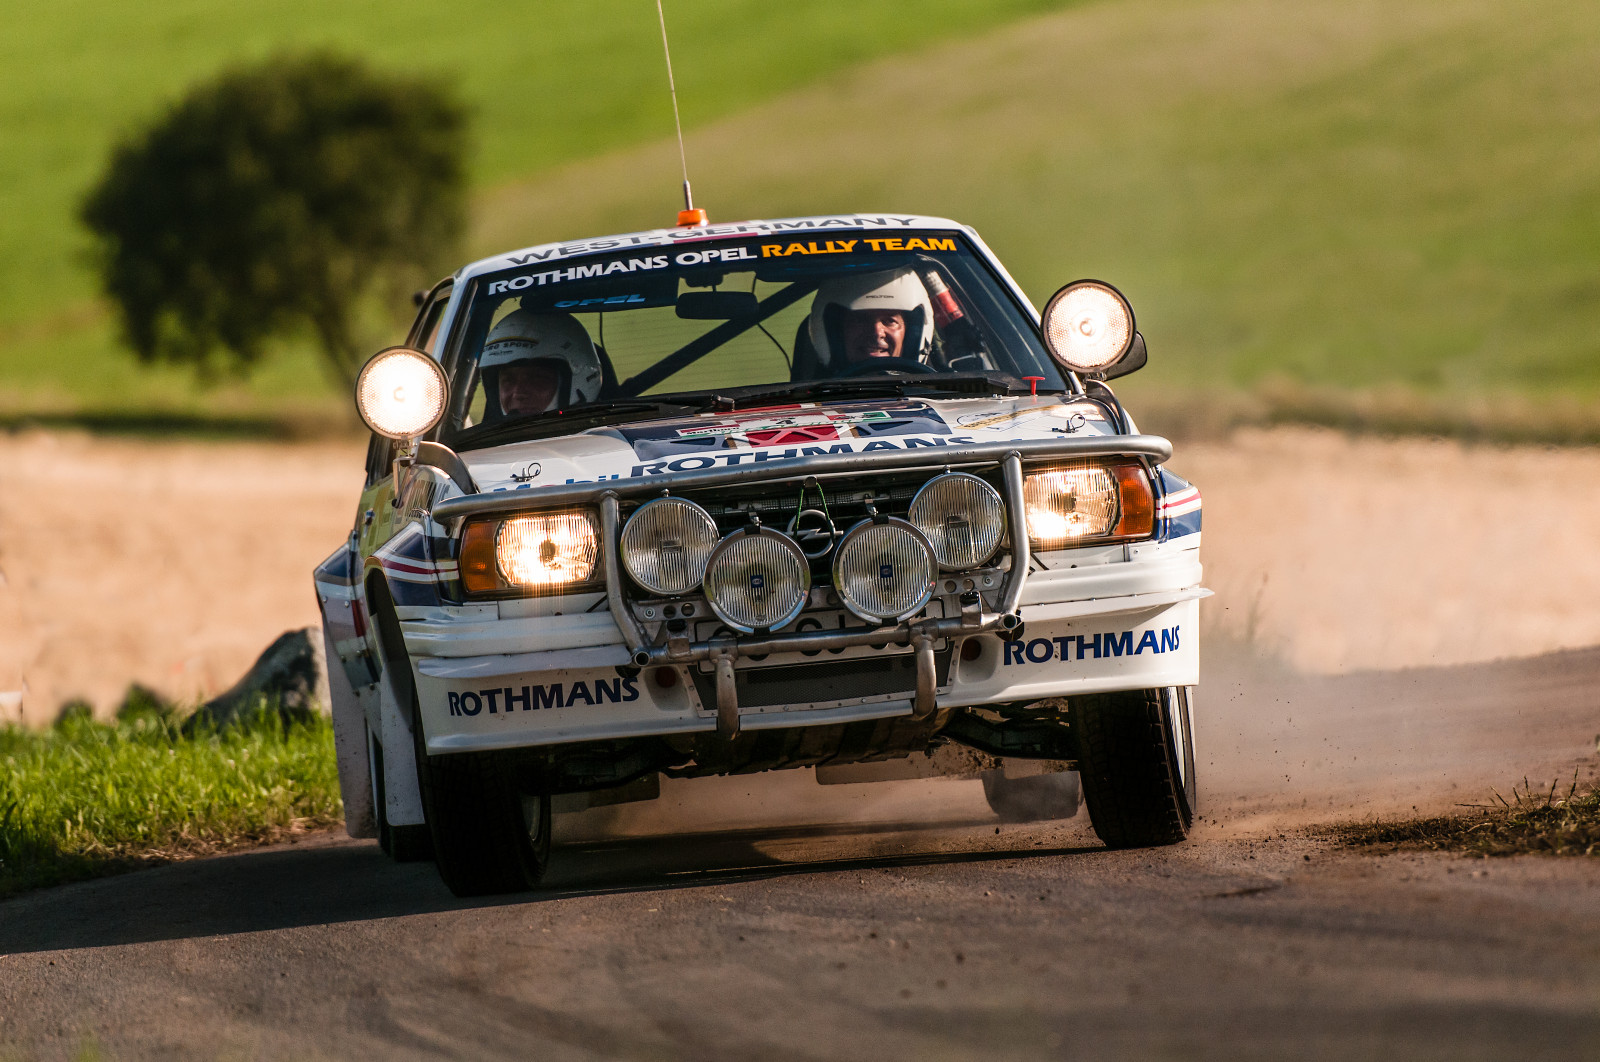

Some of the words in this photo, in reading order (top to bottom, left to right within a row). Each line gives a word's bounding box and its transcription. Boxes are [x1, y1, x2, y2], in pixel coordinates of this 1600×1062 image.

[506, 217, 918, 265] WEST-GERMANY
[488, 254, 669, 296] ROTHMANS
[675, 246, 758, 266] OPEL
[760, 239, 858, 258] RALLY
[863, 238, 957, 252] TEAM
[554, 293, 646, 308] OPEL
[1003, 624, 1180, 666] ROTHMANS
[447, 677, 640, 717] ROTHMANS
